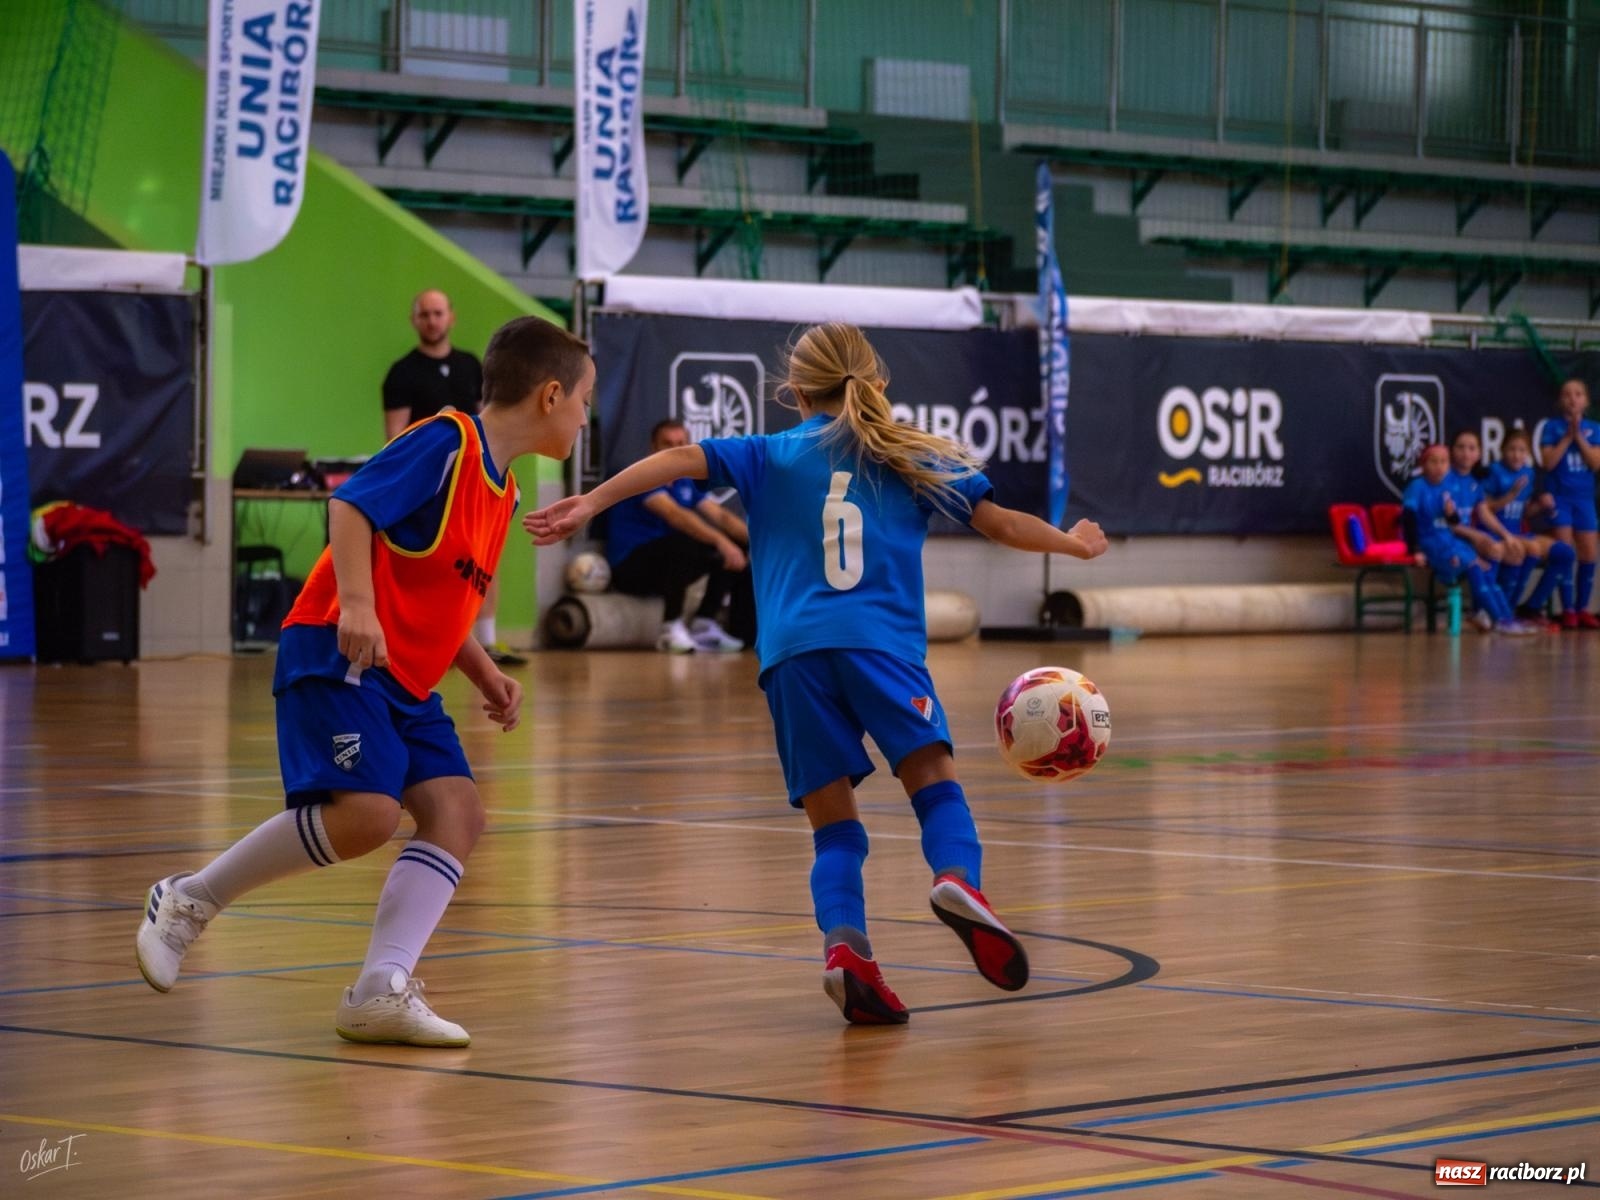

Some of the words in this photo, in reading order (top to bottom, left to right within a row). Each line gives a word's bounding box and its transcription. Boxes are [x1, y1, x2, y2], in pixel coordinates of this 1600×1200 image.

[220, 0, 235, 63] SPORT
[216, 69, 231, 121] KLUB
[236, 12, 276, 159] UNIA
[273, 0, 313, 206] RACIBÓR
[593, 46, 617, 180] UNIA
[210, 124, 227, 201] MIEJSKI
[1157, 386, 1284, 460] OSiR
[1207, 461, 1285, 488] RACIBÓRZ
[822, 471, 864, 591] 6
